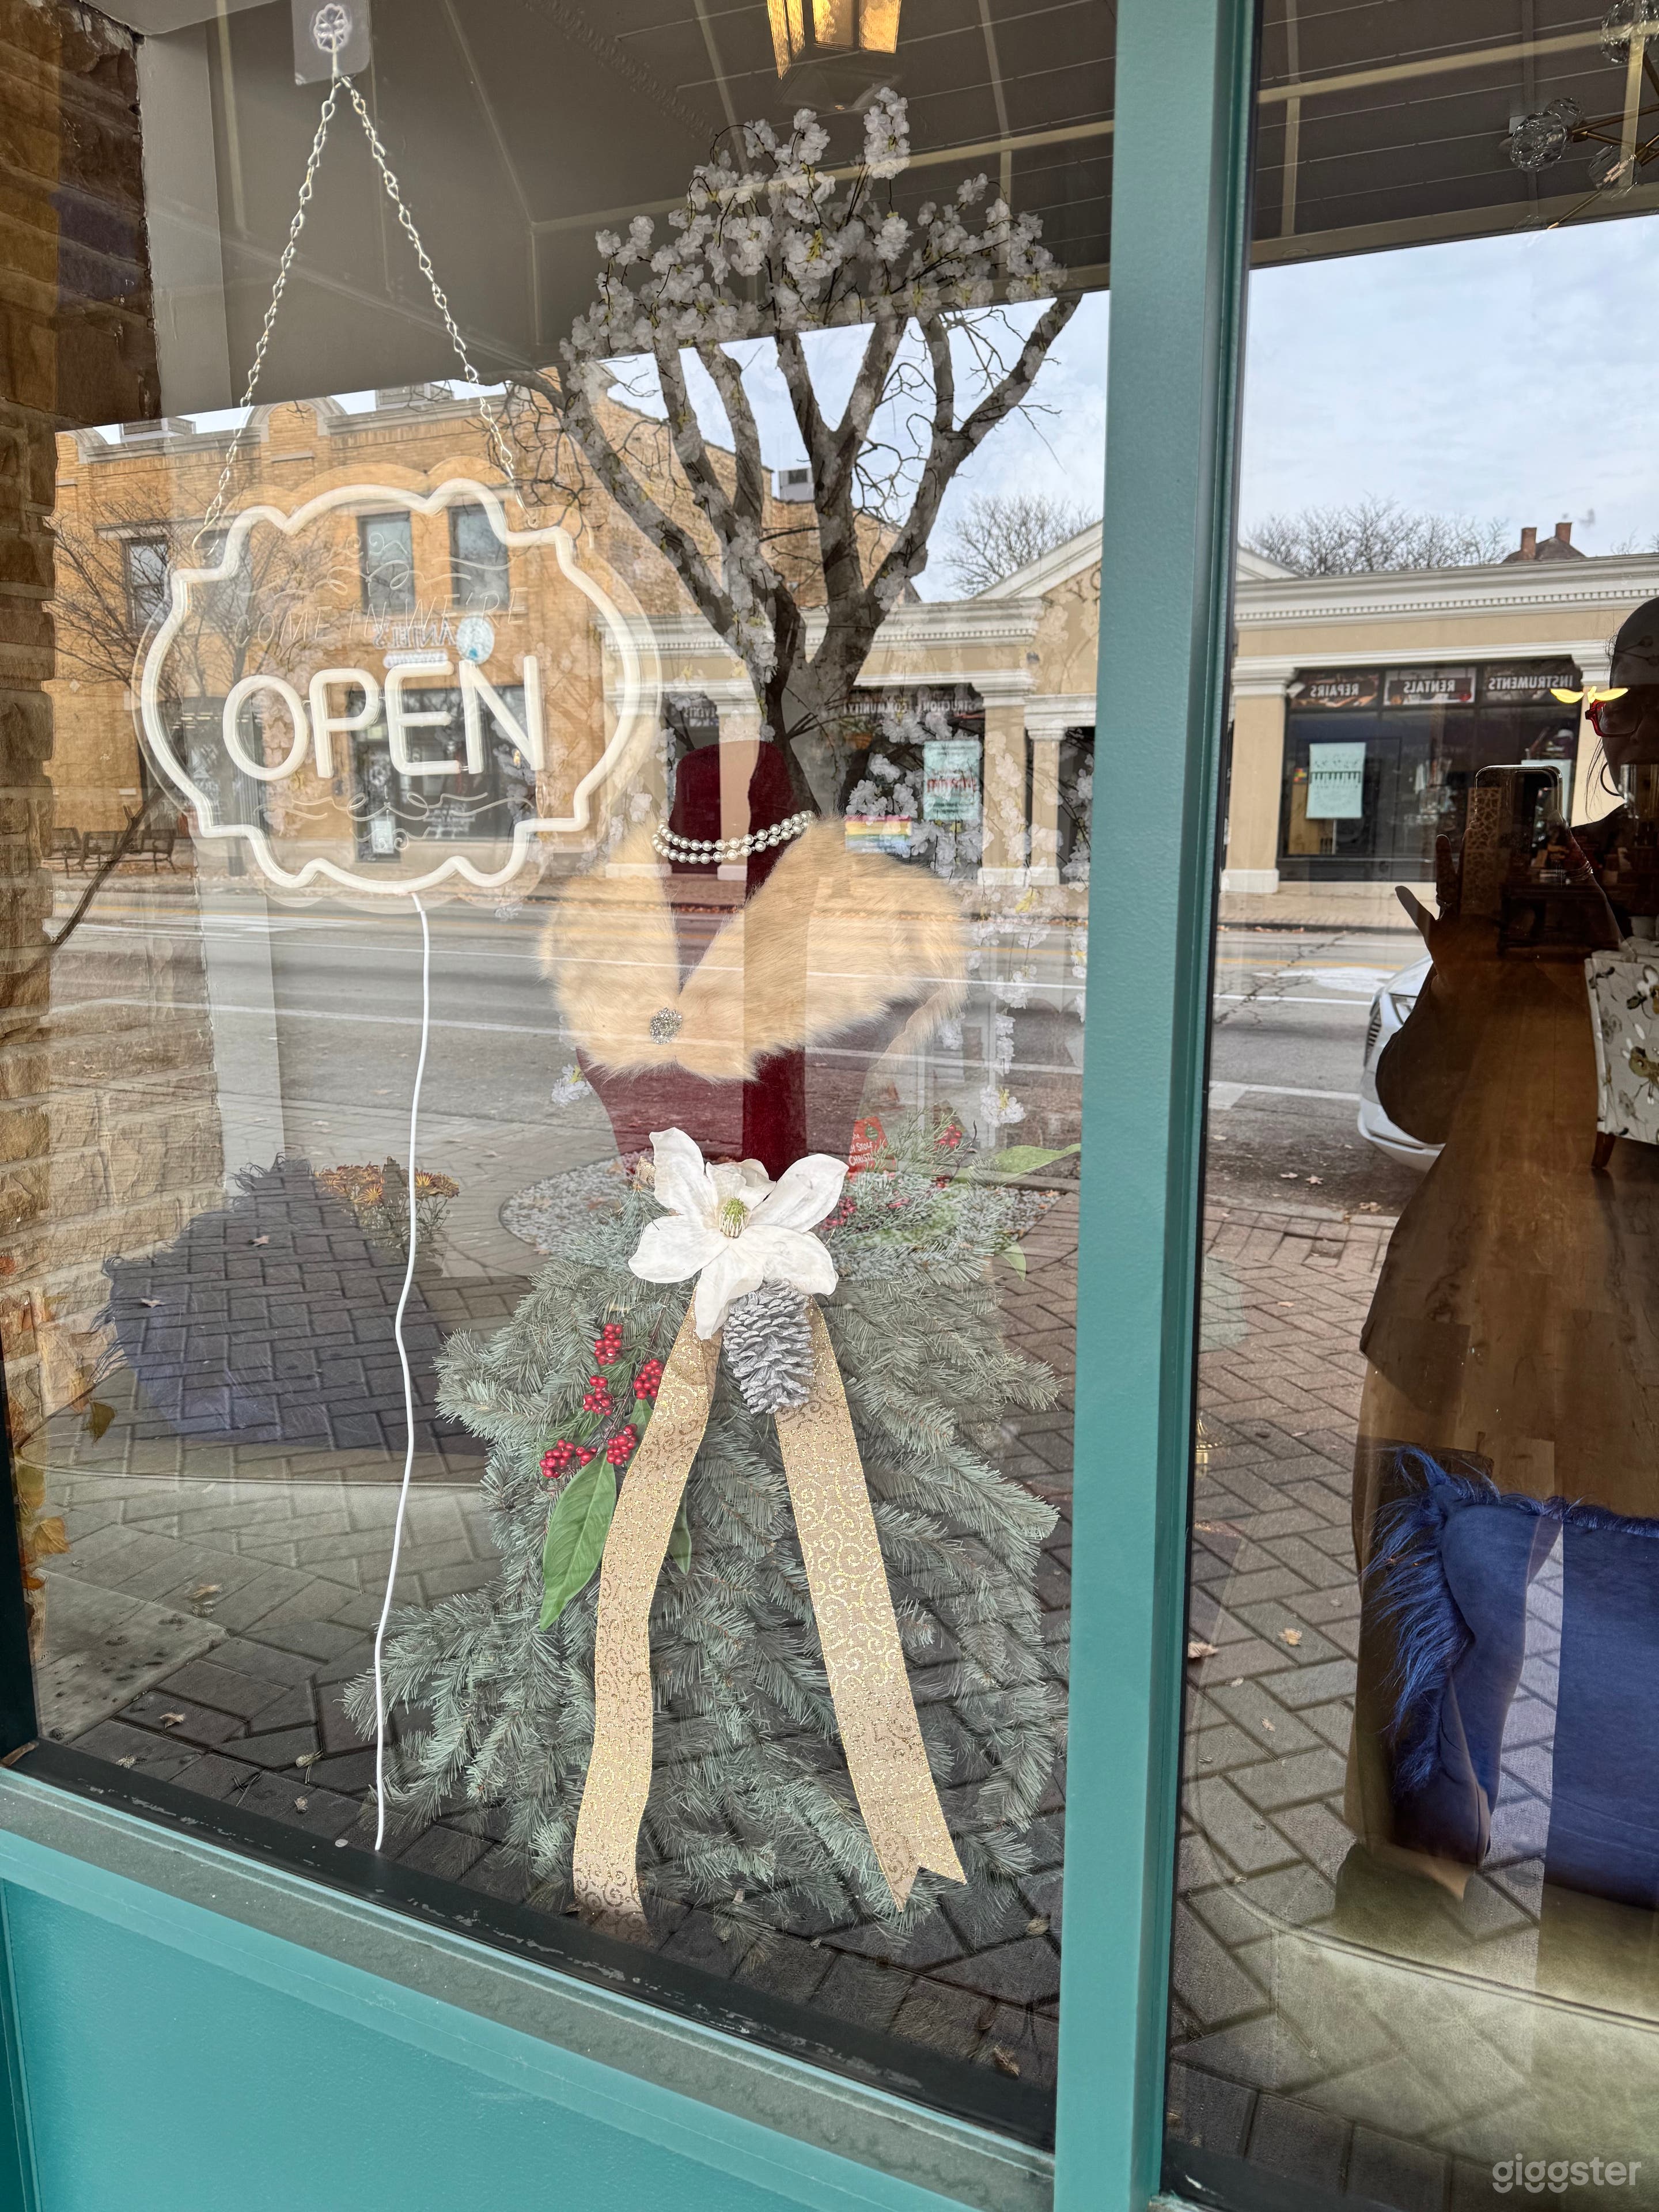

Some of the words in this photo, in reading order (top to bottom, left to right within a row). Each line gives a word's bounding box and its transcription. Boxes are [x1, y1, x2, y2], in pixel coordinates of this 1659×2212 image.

[234, 606, 333, 646] COME
[349, 601, 387, 638] IN
[406, 587, 528, 631] WE'RE
[222, 655, 545, 782] OPEN
[856, 1141, 873, 1152] STOLE
